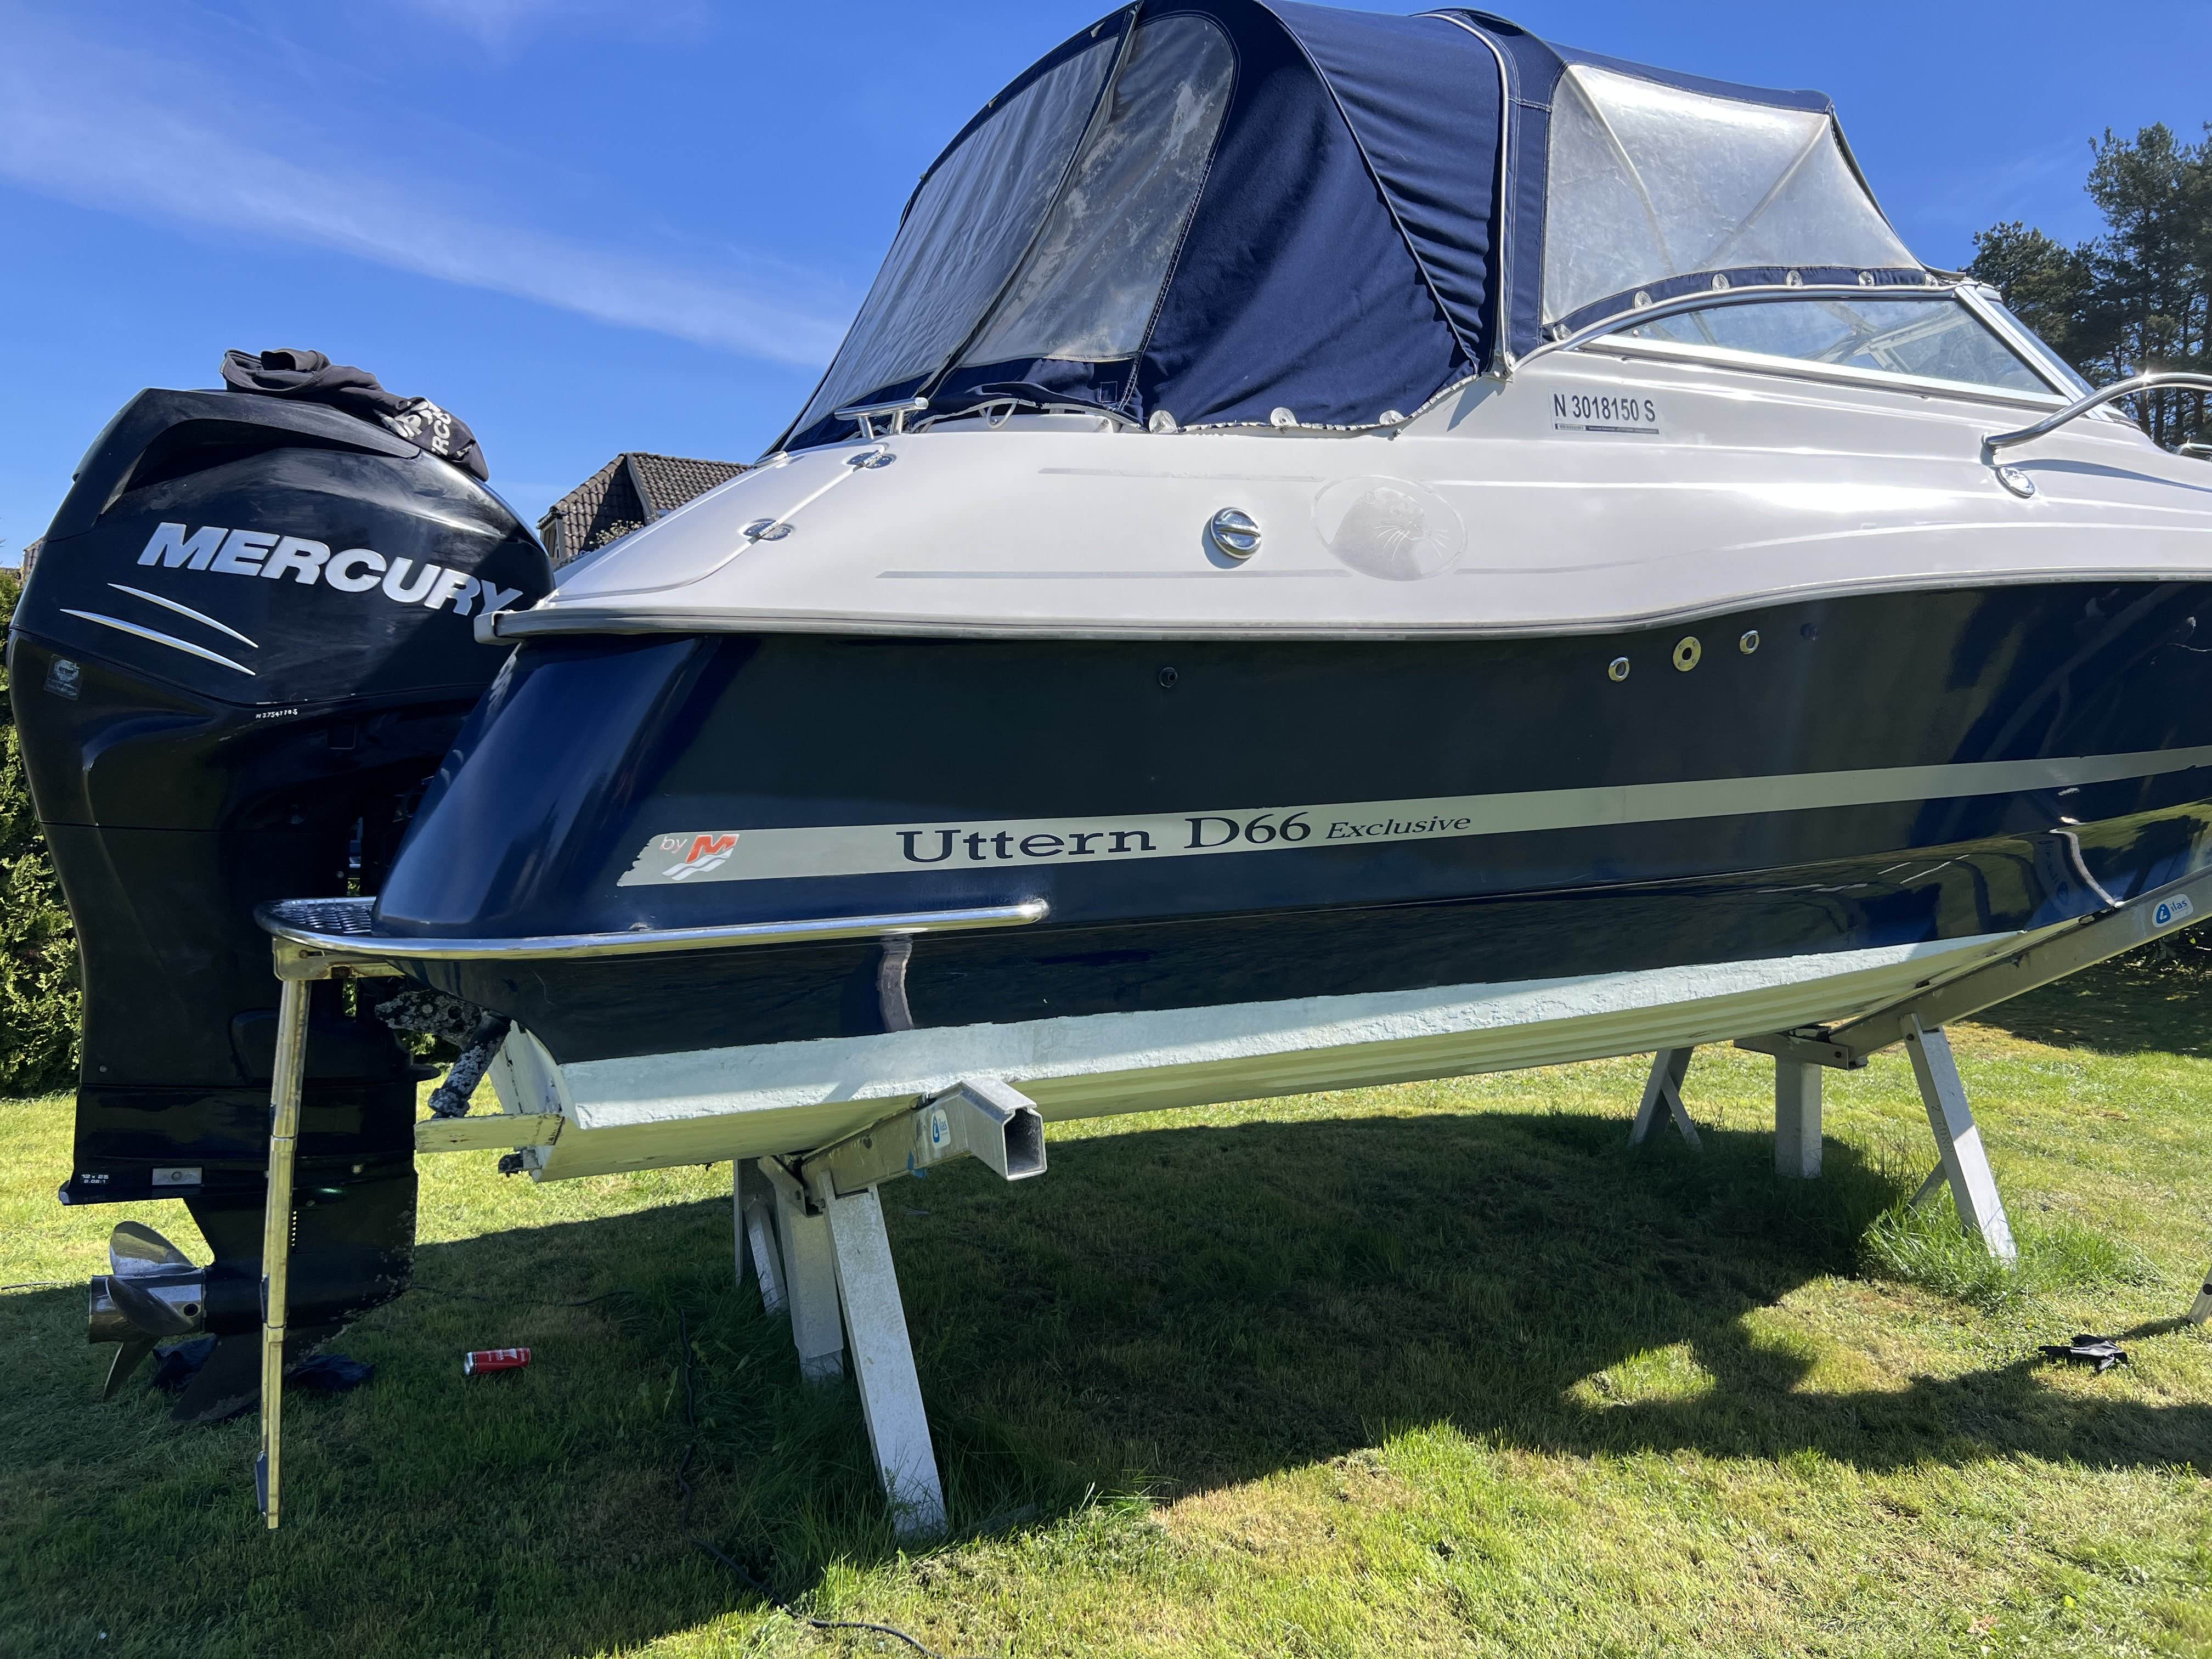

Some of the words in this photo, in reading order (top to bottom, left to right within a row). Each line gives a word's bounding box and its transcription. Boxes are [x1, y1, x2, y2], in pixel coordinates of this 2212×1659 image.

[1553, 393, 1566, 417] N
[1571, 395, 1639, 422] 3018150
[1644, 399, 1656, 422] S
[137, 522, 523, 616] MERCURY
[660, 836, 687, 854] by
[895, 829, 1156, 863] Uttern
[1183, 812, 1311, 849] D66
[1325, 816, 1471, 839] Exclusive
